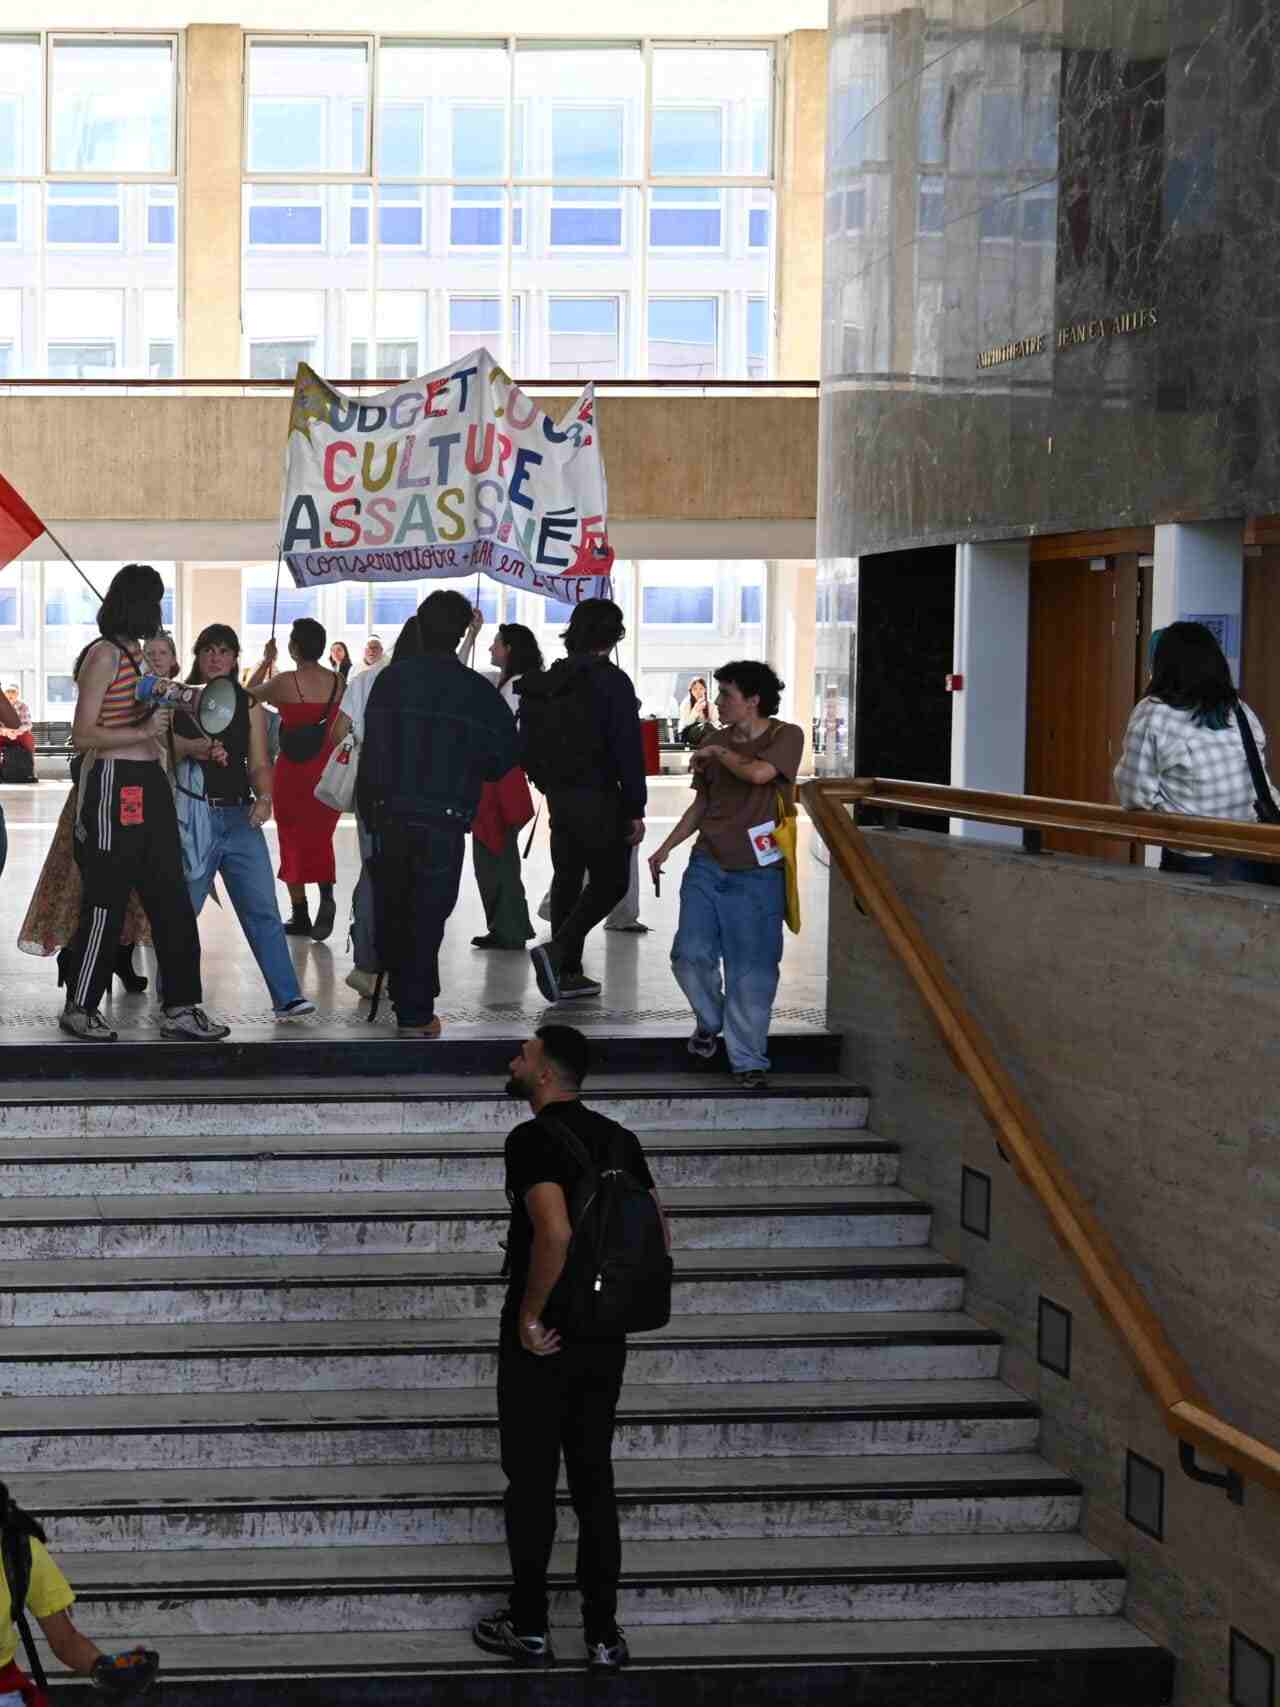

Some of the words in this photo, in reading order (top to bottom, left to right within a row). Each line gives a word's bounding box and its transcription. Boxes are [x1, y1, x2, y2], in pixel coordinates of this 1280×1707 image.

[1088, 307, 1158, 338] CAAILLES
[310, 367, 477, 433] UDGET
[496, 554, 525, 580] en
[533, 571, 592, 603] LTTE
